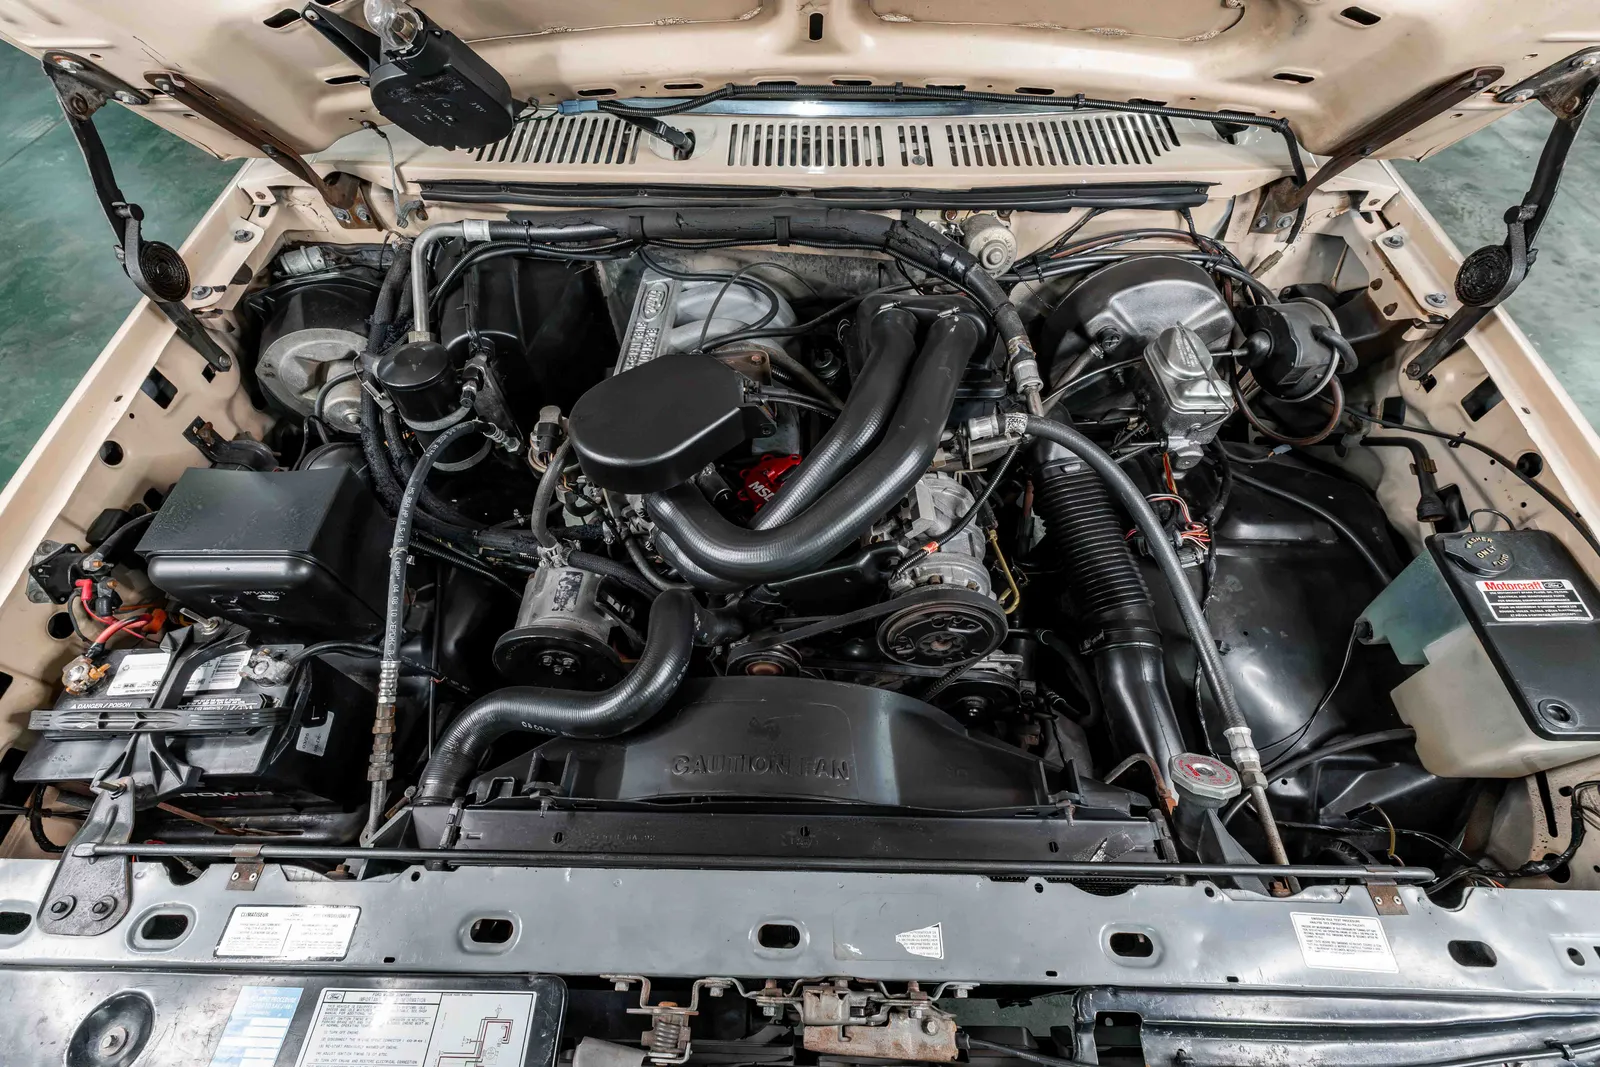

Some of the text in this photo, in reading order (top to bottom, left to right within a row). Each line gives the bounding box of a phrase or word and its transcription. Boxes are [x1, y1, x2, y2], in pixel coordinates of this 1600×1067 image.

[1465, 536, 1492, 548] WASHER
[1476, 546, 1496, 558] ONLY
[1484, 582, 1543, 590] Motorcraft
[672, 754, 850, 780] CAUTION FAN
